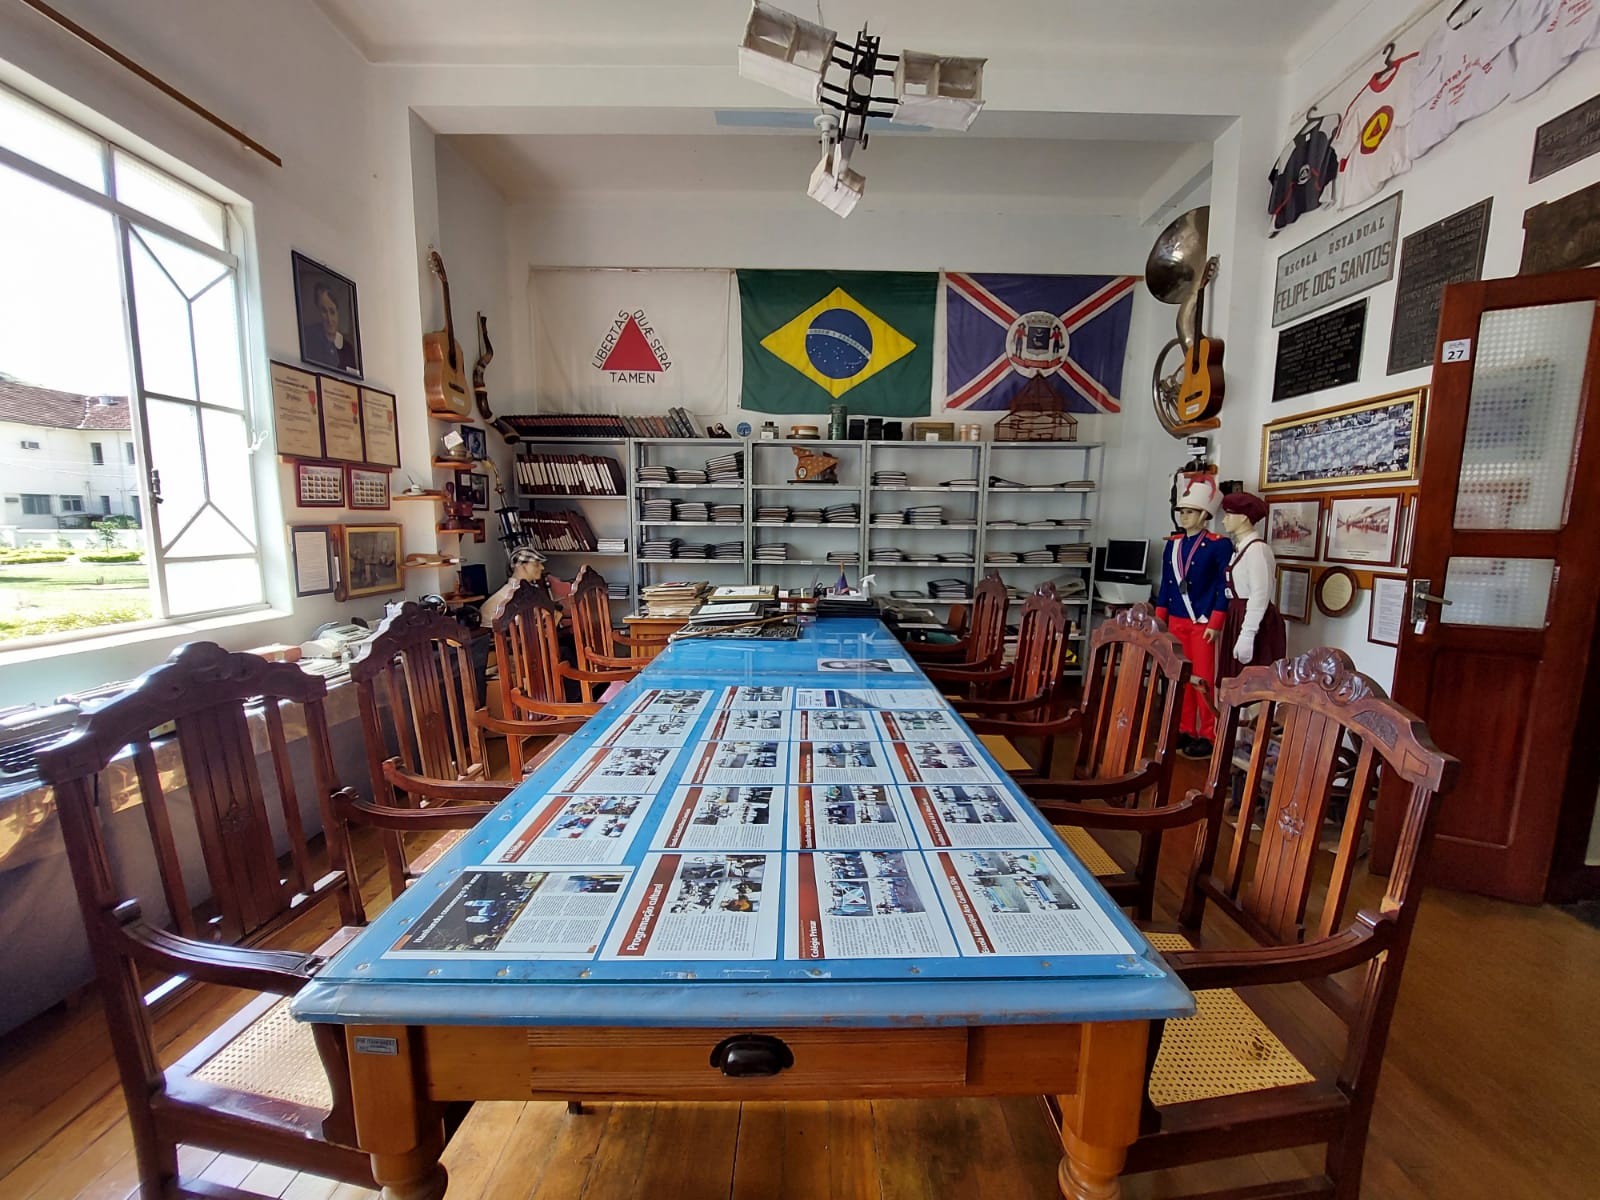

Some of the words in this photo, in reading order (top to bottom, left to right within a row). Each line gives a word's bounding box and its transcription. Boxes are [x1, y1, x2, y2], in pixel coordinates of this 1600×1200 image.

[1284, 251, 1318, 277] ESCOLA
[1328, 216, 1385, 256] ESTADUAL
[1275, 278, 1309, 314] FELIPE
[1312, 266, 1336, 297] DOS
[1340, 241, 1391, 286] SANTOS
[592, 309, 629, 369] LIBERTAS
[650, 338, 672, 372] SERA
[1447, 349, 1464, 360] 27
[609, 371, 655, 384] TAMEN
[626, 906, 655, 951] Programação
[648, 883, 664, 905] cultural
